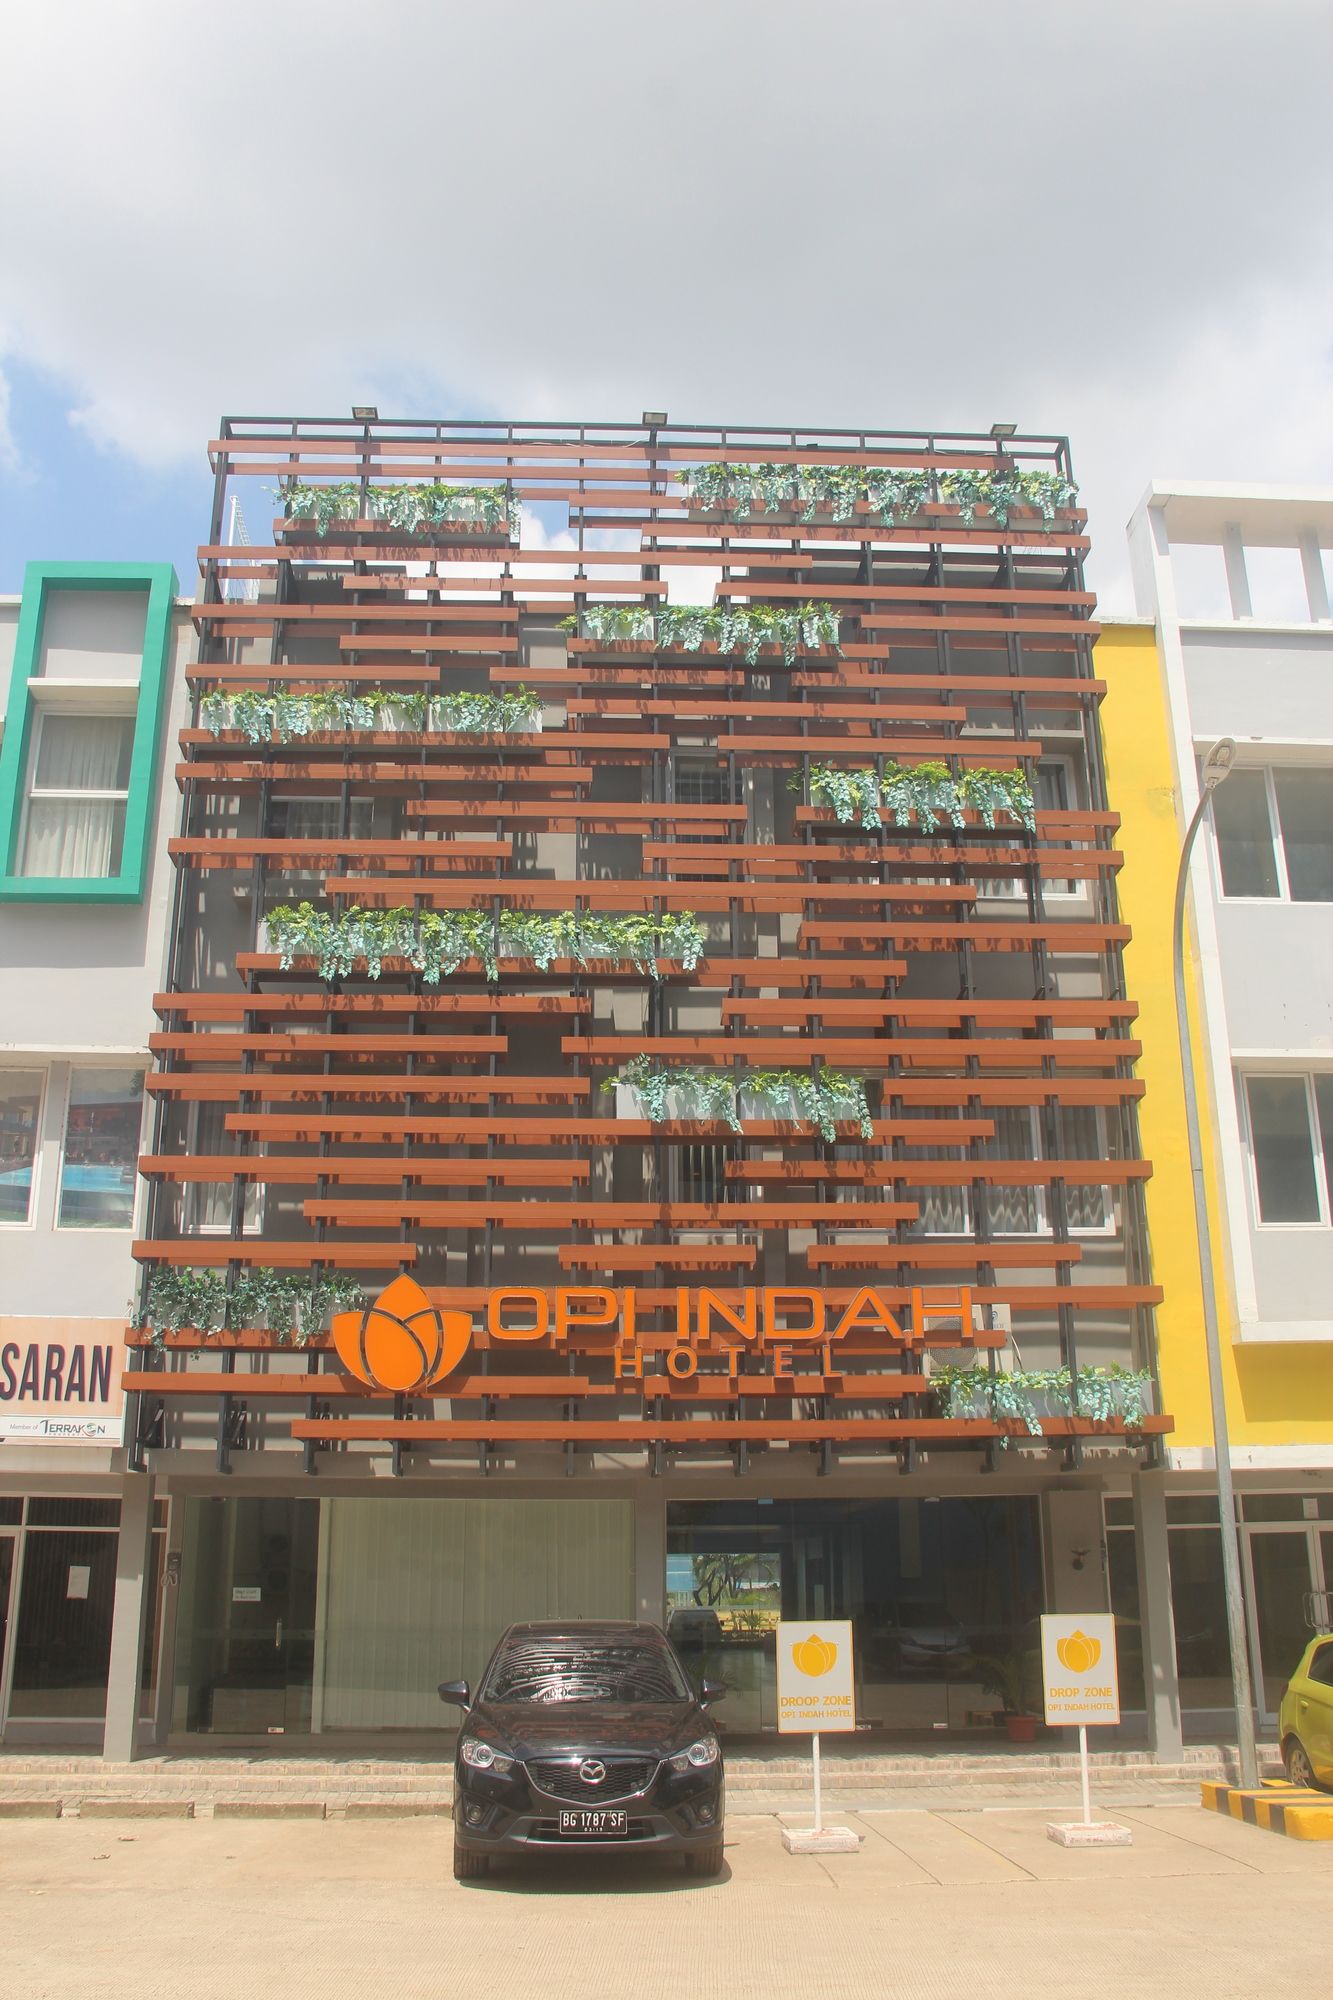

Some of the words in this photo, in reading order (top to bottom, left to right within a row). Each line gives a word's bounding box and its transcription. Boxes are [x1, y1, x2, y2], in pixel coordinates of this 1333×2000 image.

[488, 1285, 636, 1340] OPI
[677, 1285, 975, 1340] INDAH
[614, 1345, 843, 1379] HOTEL
[0, 1342, 113, 1402] SARAN
[1049, 1687, 1080, 1698] DROP
[1083, 1687, 1113, 1697] ZONE
[780, 1696, 820, 1707] DROOP
[823, 1695, 852, 1706] ZONE
[1063, 1703, 1089, 1711] INDAH
[1090, 1702, 1115, 1710] HOTEL
[799, 1710, 825, 1719] INDAH
[826, 1709, 851, 1718] HOTEL
[563, 1813, 577, 1826] BG
[581, 1813, 606, 1826] 1787
[611, 1813, 624, 1826] SF
